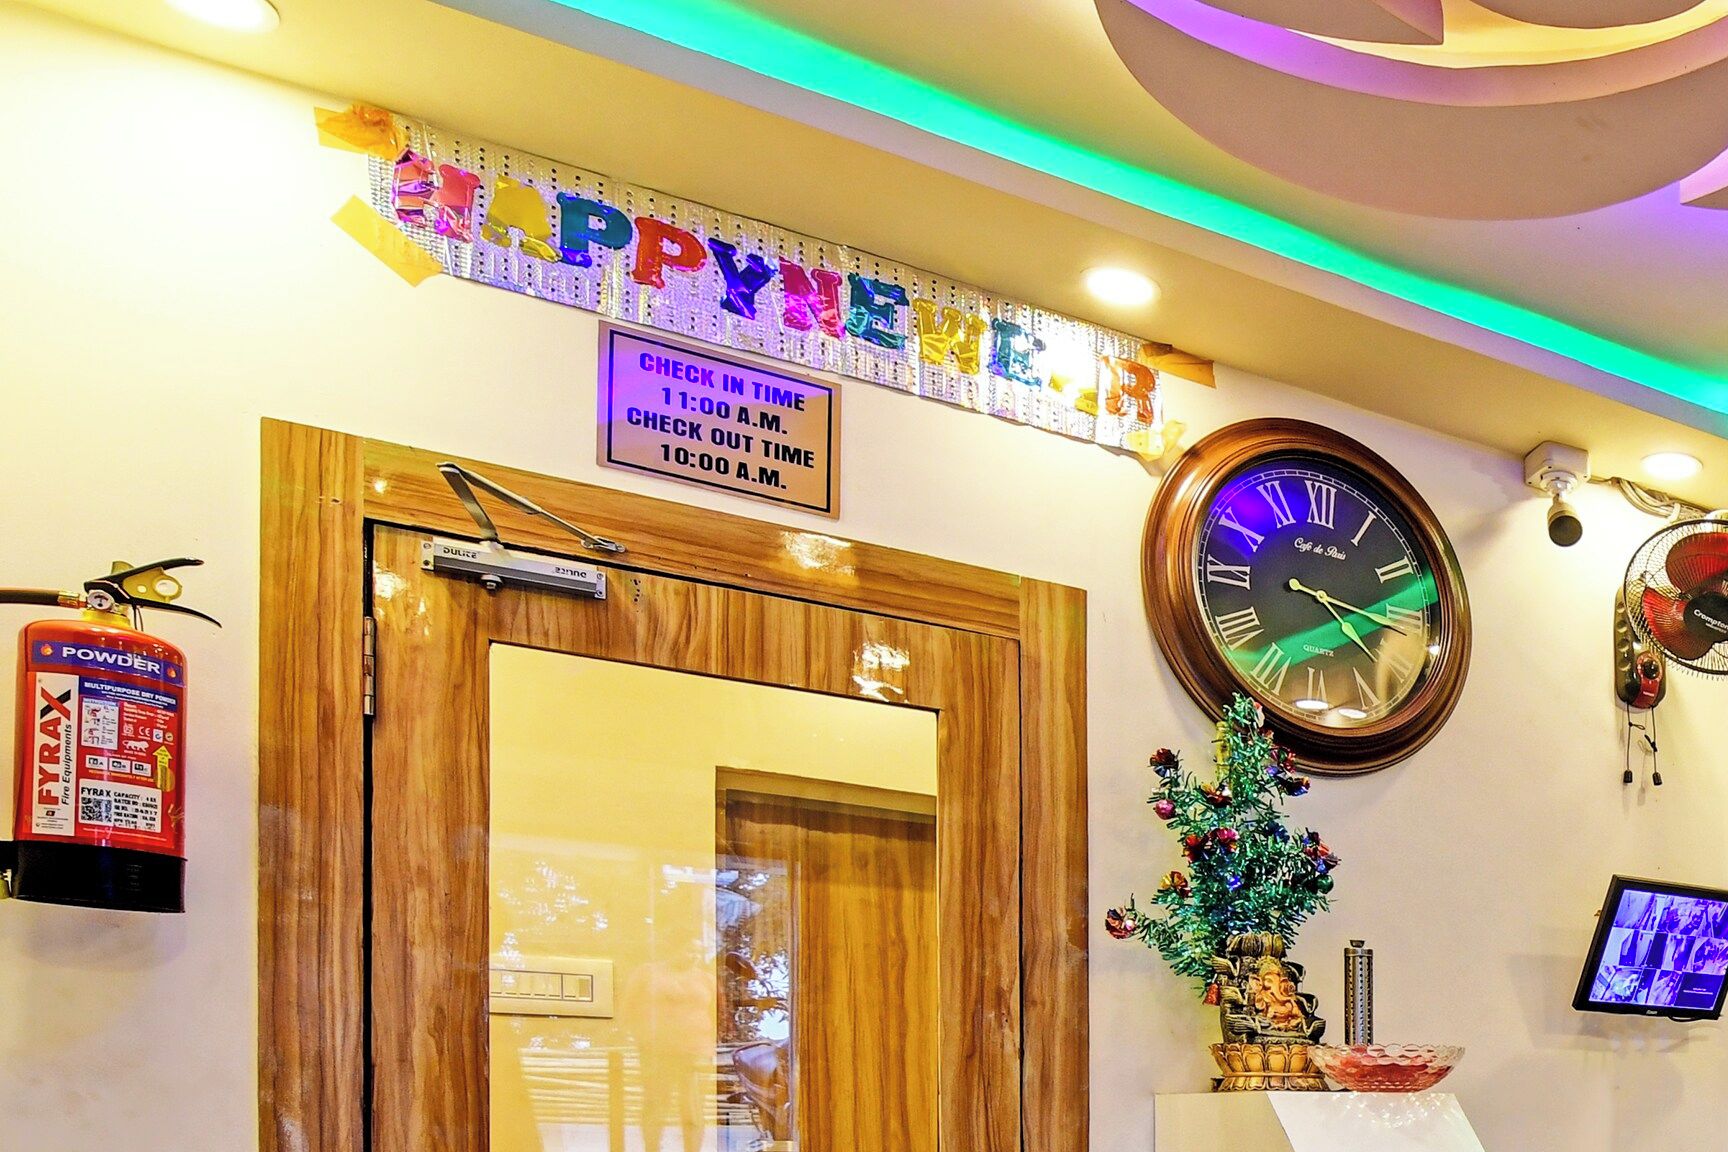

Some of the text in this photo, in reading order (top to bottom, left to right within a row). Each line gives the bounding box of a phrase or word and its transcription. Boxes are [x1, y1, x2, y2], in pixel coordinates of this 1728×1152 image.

[640, 352, 805, 412] CHECK IN TIME
[662, 387, 788, 434] 11:00 A.M.
[626, 407, 815, 469] CHECK OUT TIME
[660, 444, 787, 490] 10:00 A.M.
[1256, 480, 1296, 529] XI
[1304, 480, 1337, 529] XII
[1324, 546, 1346, 560] Paris
[62, 646, 161, 674] POWDER
[1303, 644, 1335, 657] QUARTZ
[84, 682, 140, 696] MULTIPURPOSE
[38, 686, 71, 806] FYRAX
[61, 724, 73, 806] Fire Equipments
[81, 786, 111, 798] FYRAX
[114, 792, 140, 800] CAPACITY
